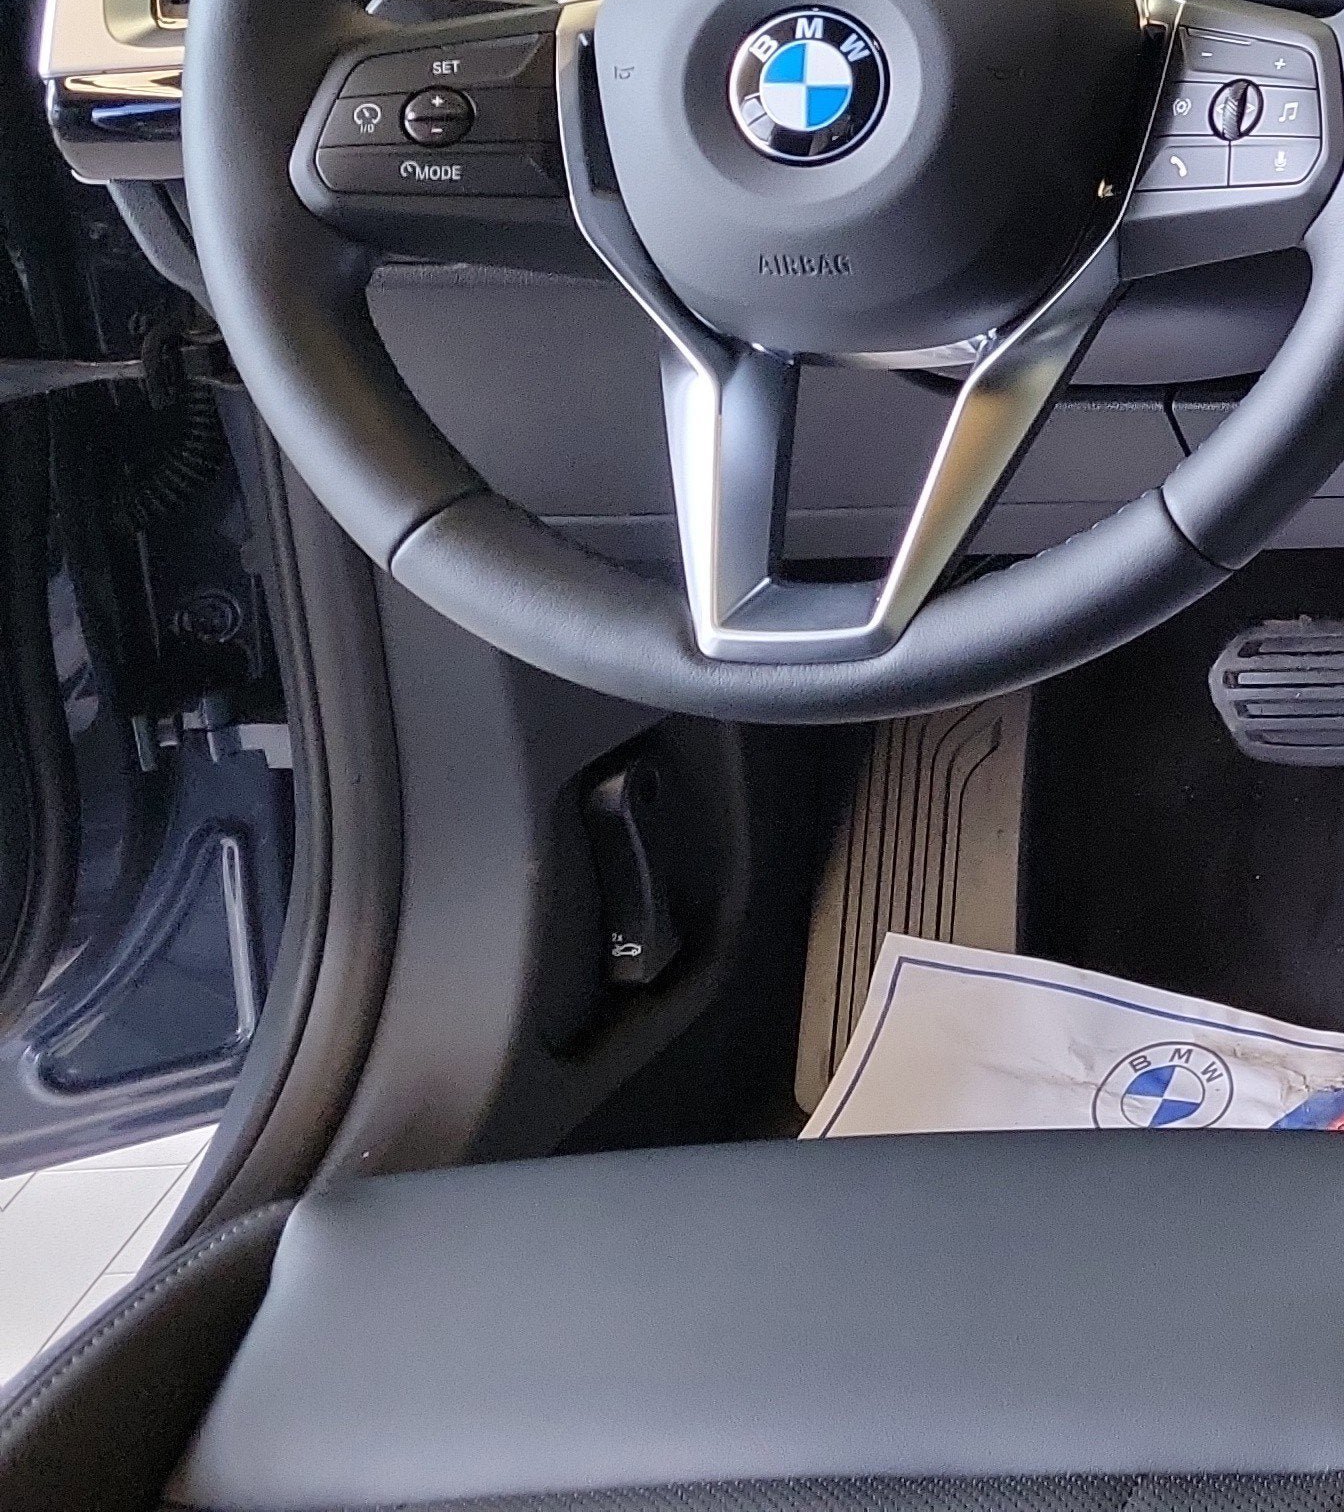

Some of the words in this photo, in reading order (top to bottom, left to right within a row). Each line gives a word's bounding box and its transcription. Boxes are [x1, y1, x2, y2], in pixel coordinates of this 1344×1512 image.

[748, 17, 871, 63] BMW
[432, 59, 461, 75] SET
[415, 165, 461, 180] MODE
[759, 253, 852, 275] AIRBAG
[1128, 1047, 1224, 1083] BMW
